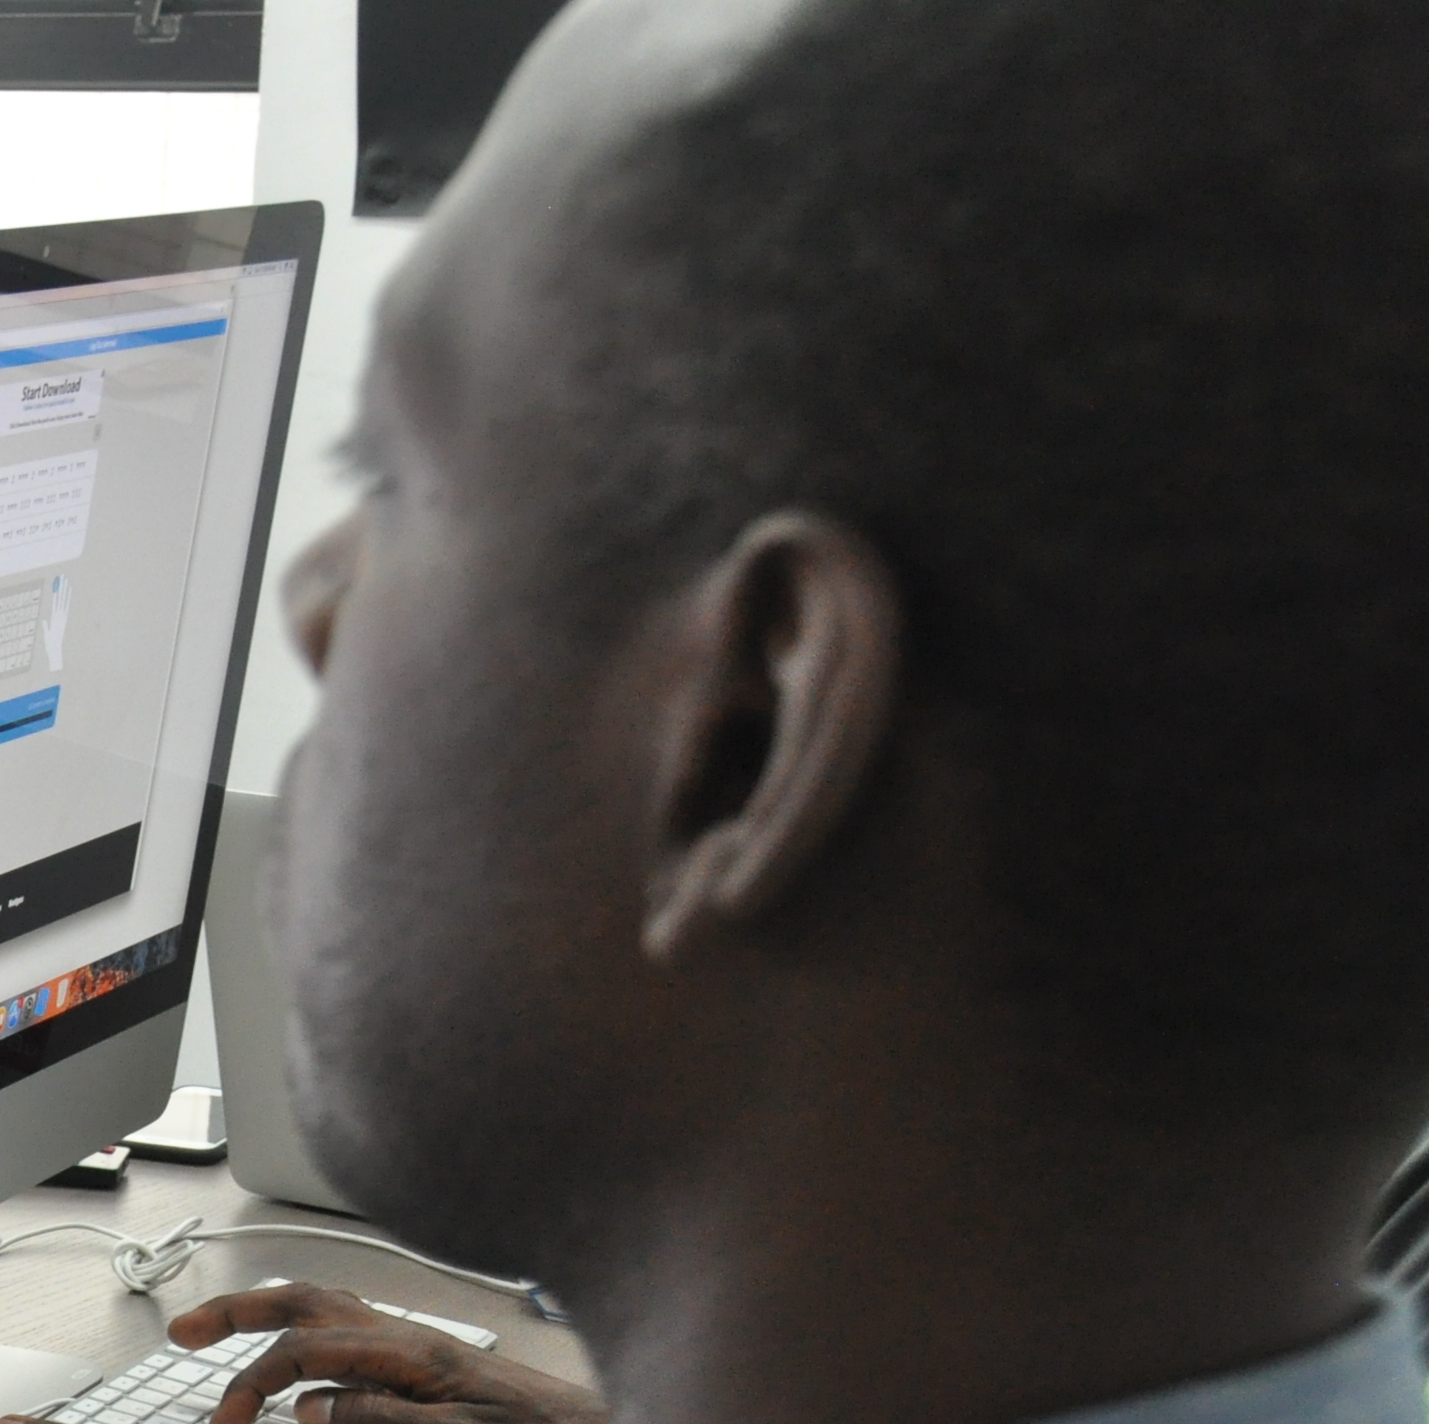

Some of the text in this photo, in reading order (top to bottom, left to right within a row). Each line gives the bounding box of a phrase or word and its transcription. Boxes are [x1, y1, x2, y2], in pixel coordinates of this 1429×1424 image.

[21, 376, 83, 402] Start Download
[8, 896, 25, 908] Badges
